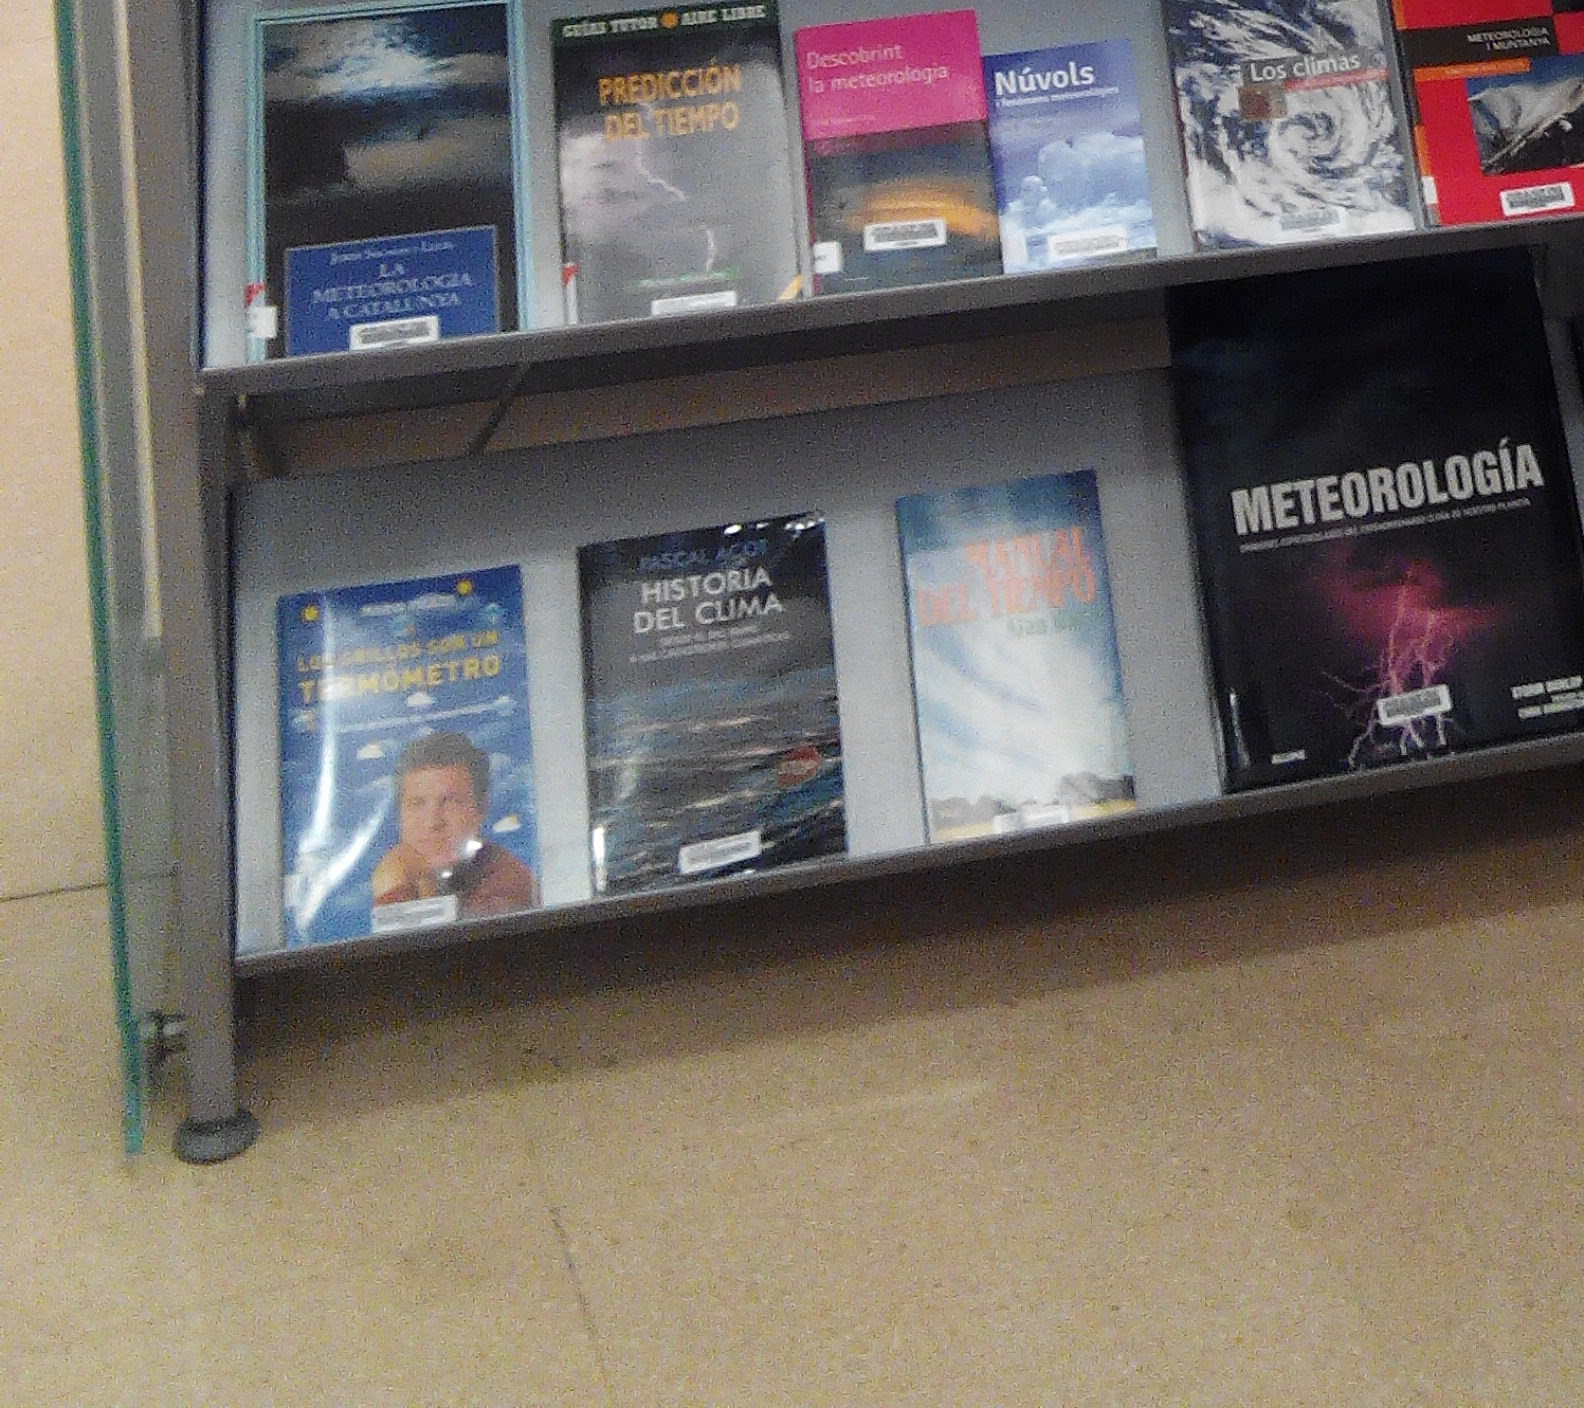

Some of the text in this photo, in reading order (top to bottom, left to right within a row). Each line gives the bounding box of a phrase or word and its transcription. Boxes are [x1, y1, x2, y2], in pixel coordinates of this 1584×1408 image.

[682, 10, 718, 26] AIRE
[722, 5, 766, 22] LIBRE
[806, 45, 905, 70] Descobrint
[1250, 53, 1362, 83] Los climas
[808, 63, 949, 93] la meteorologia
[994, 60, 1095, 95] Núvols
[604, 100, 741, 143] DEL TIEMPO
[1231, 436, 1545, 536] METEOROLOGÍA
[640, 565, 773, 605] HISTORIA
[633, 592, 784, 634] DEL CLIMA
[915, 584, 978, 627] DEL
